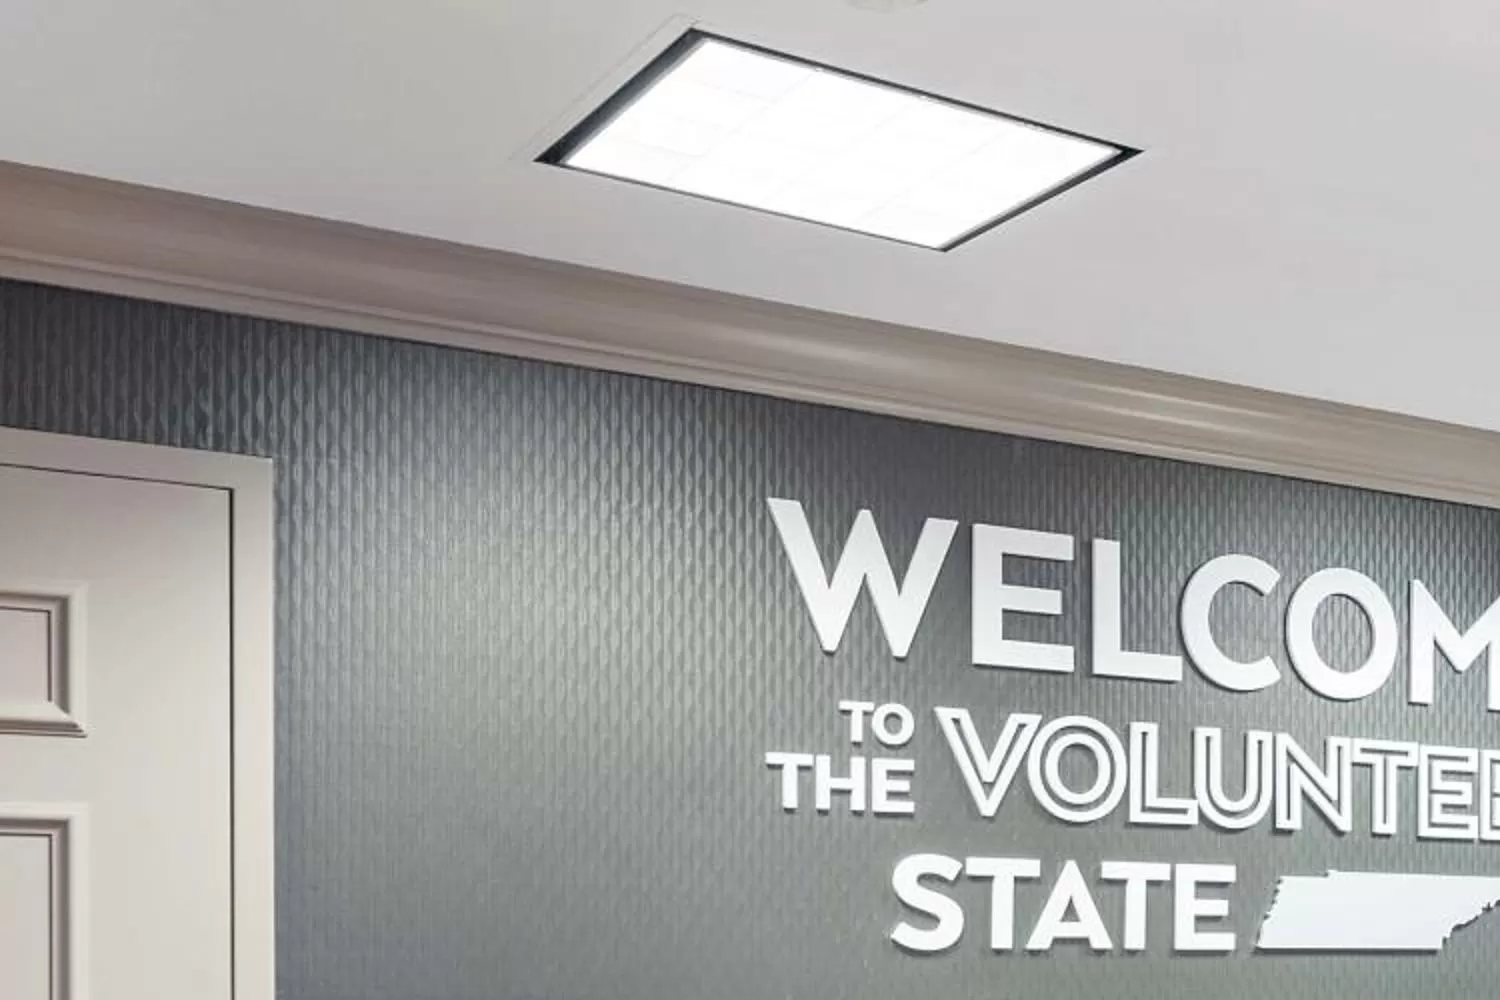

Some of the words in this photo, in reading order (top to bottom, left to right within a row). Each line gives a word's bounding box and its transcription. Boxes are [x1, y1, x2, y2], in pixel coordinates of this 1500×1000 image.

[839, 699, 915, 746] TO
[766, 751, 915, 814] THE
[890, 853, 1237, 953] STATE
